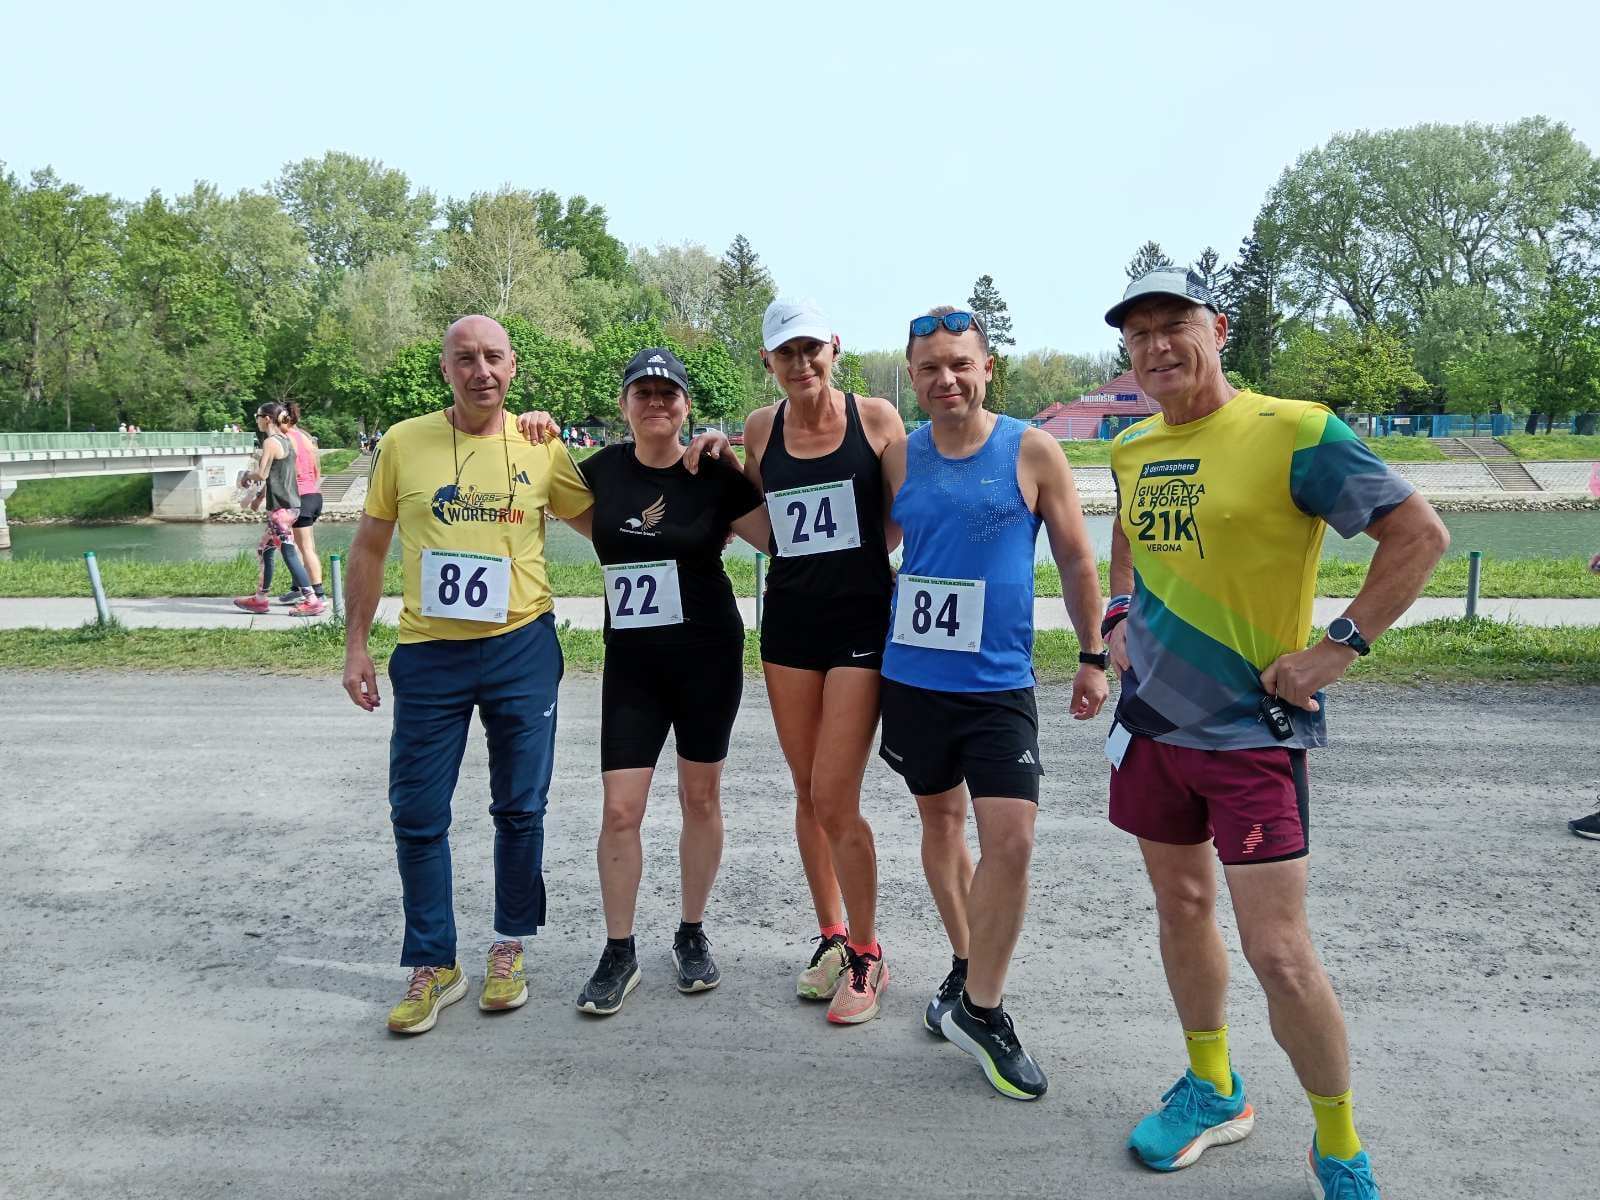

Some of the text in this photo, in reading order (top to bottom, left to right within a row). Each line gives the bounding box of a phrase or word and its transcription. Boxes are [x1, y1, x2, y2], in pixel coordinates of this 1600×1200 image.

[1149, 463, 1195, 473] dermasphere
[1138, 495, 1200, 507] & ROMEO
[1139, 484, 1206, 496] GIULIETTA
[787, 496, 838, 543] 24
[1147, 543, 1182, 552] VERONA
[439, 563, 488, 607] 86
[615, 575, 659, 616] 22
[912, 590, 960, 637] 84
